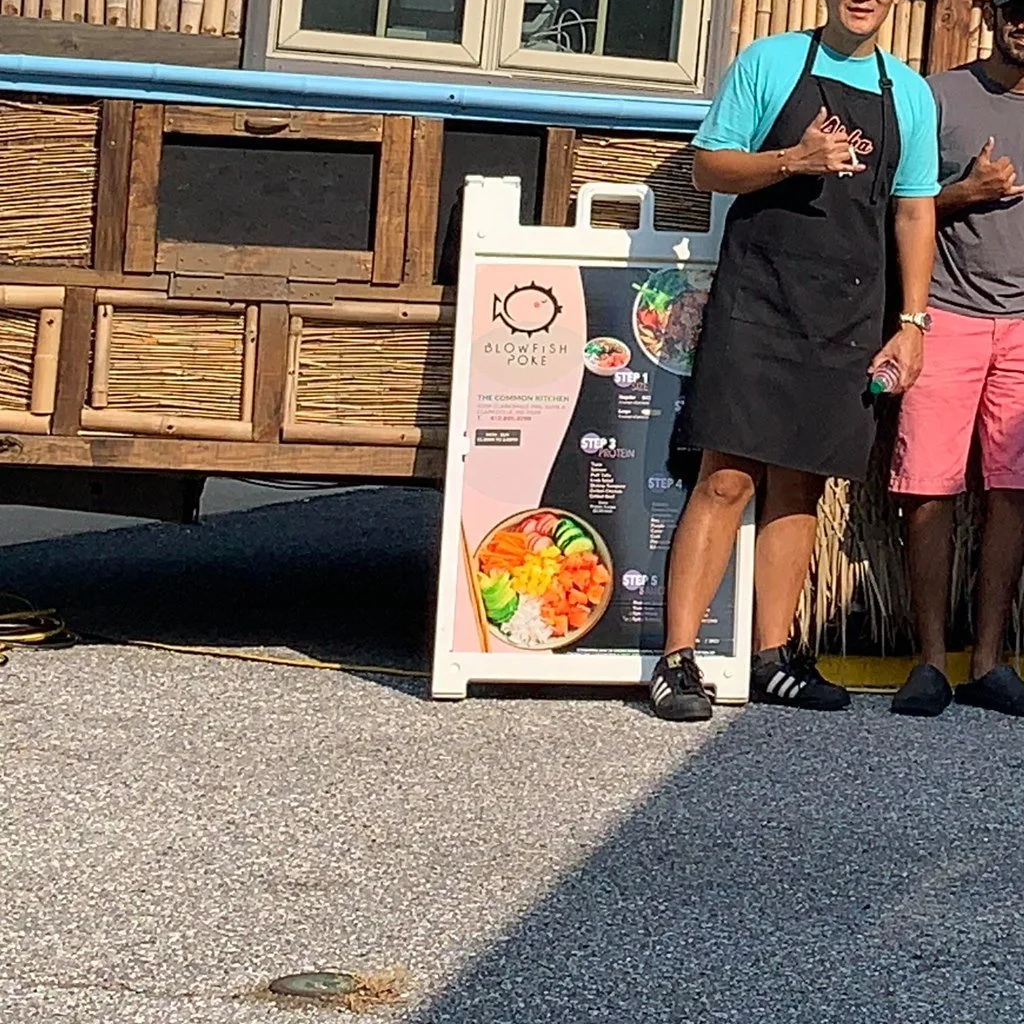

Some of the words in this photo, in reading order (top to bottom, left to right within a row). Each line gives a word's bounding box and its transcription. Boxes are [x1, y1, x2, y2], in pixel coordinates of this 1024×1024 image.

[820, 115, 873, 155] Aha
[484, 342, 567, 354] BLOWFISH
[507, 354, 547, 366] POKE
[614, 372, 641, 383] STEP
[642, 372, 648, 384] 1
[580, 437, 608, 449] STEP
[608, 437, 616, 449] 3
[599, 448, 635, 457] PROTEIN
[648, 477, 675, 489] STEP
[675, 479, 682, 489] 4
[622, 574, 648, 586] STEP
